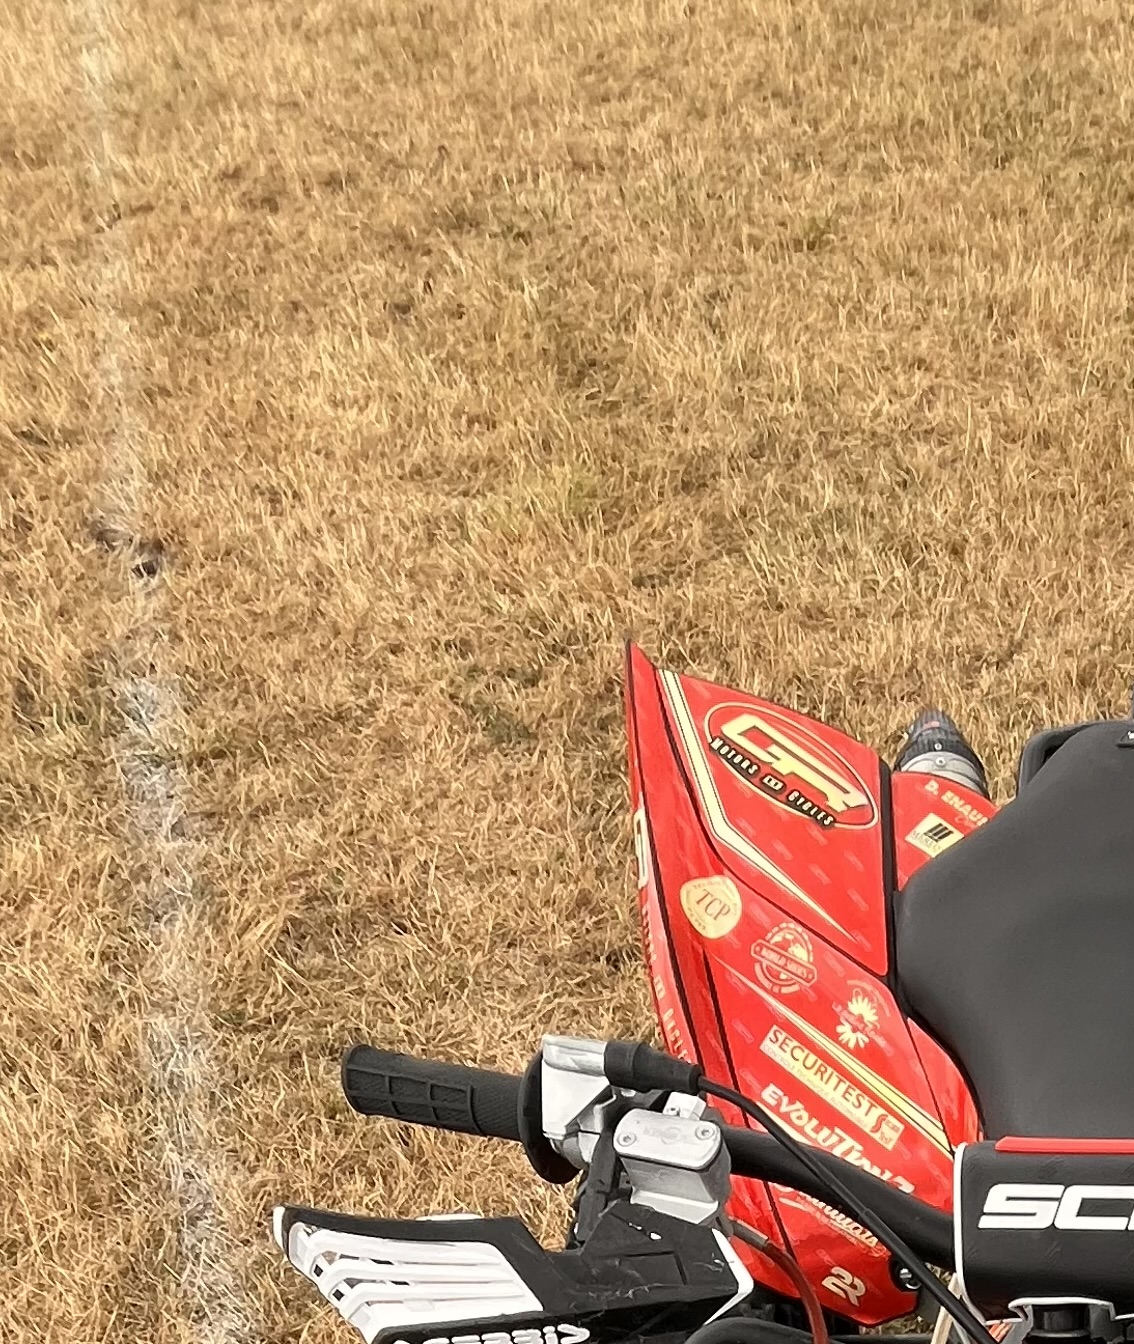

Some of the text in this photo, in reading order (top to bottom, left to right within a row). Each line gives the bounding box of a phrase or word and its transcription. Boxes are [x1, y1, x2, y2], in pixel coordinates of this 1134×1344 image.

[711, 737, 759, 775] MOTORS
[788, 791, 834, 826] CYCLES
[696, 888, 731, 921] TCP
[769, 1029, 879, 1117] SECURITEST
